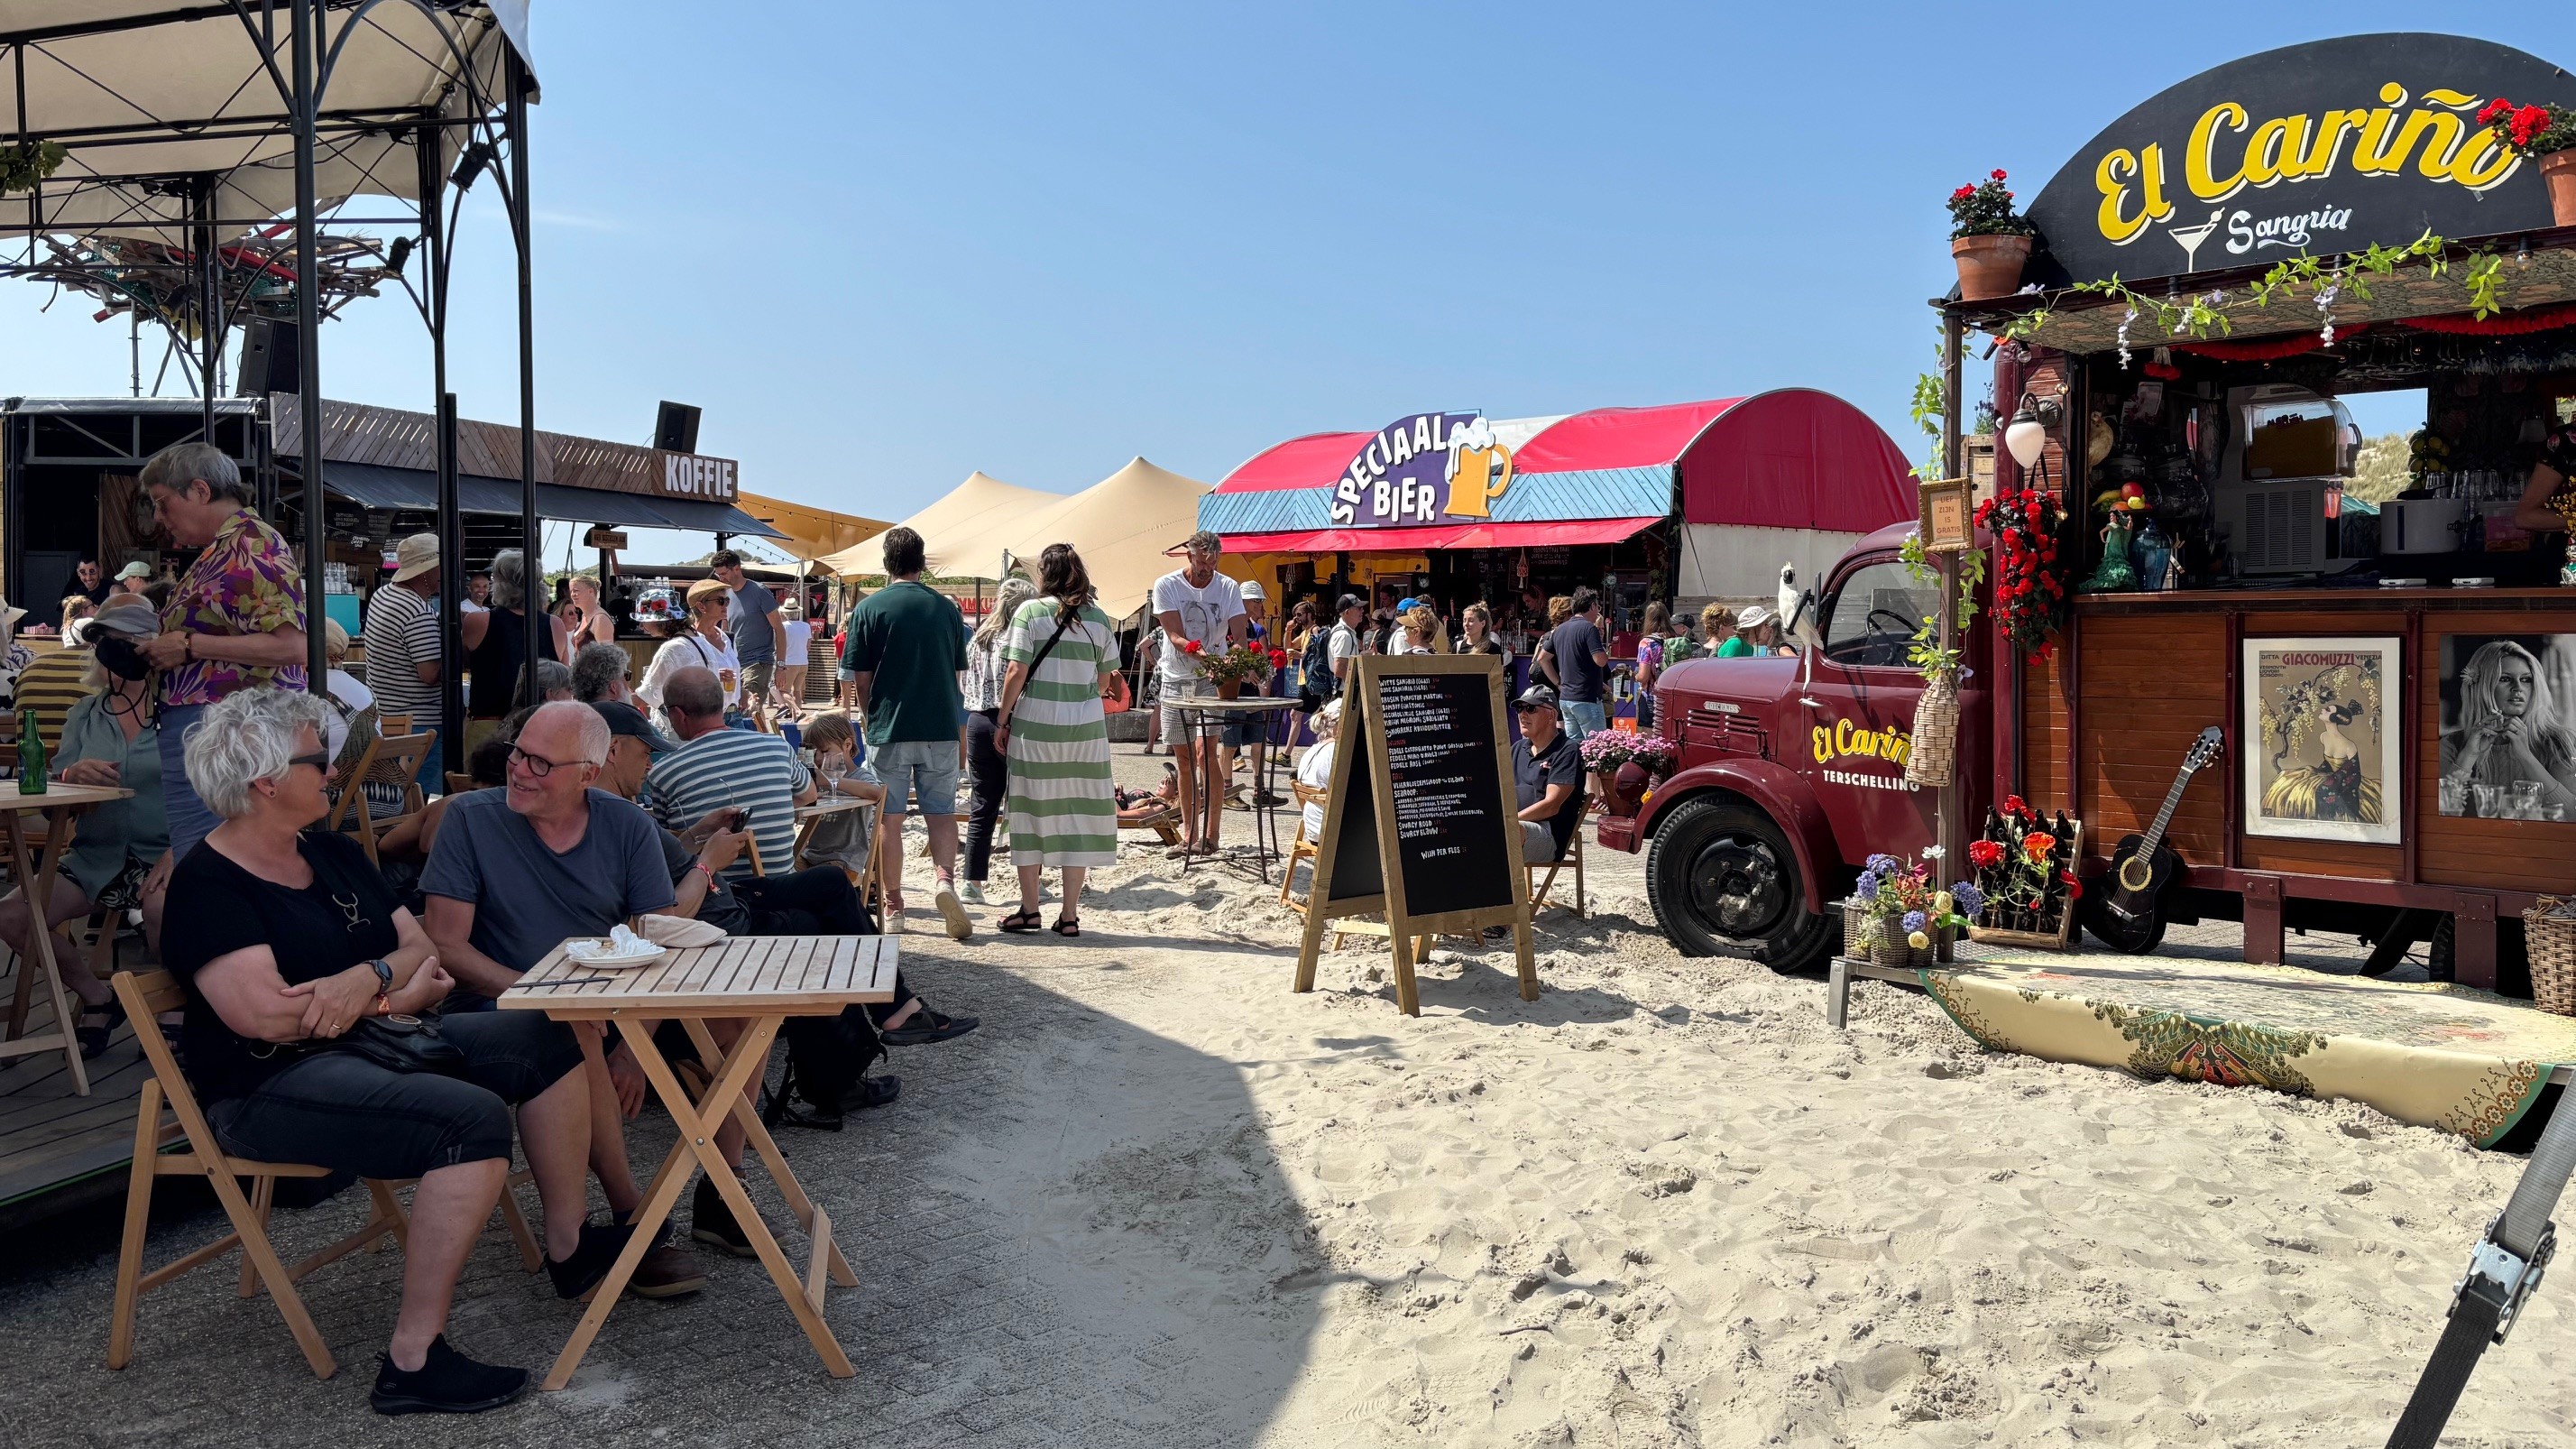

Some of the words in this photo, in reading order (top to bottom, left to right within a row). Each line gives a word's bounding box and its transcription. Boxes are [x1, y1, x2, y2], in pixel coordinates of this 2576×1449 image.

[2095, 142, 2175, 246] El
[2185, 81, 2523, 203] Cariño
[2225, 204, 2352, 255] Sangria
[666, 454, 731, 497] KOFFIE
[1330, 415, 1447, 524] SPECIAAL
[1374, 476, 1436, 522] BIER
[1937, 526, 1961, 534] GRATIS
[2282, 652, 2355, 666] GIACOMUZZI
[1812, 724, 1835, 764] El
[1835, 718, 1912, 767] Cariñ
[1823, 770, 1920, 792] TERSCHELLING
[1436, 848, 1447, 856] PER
